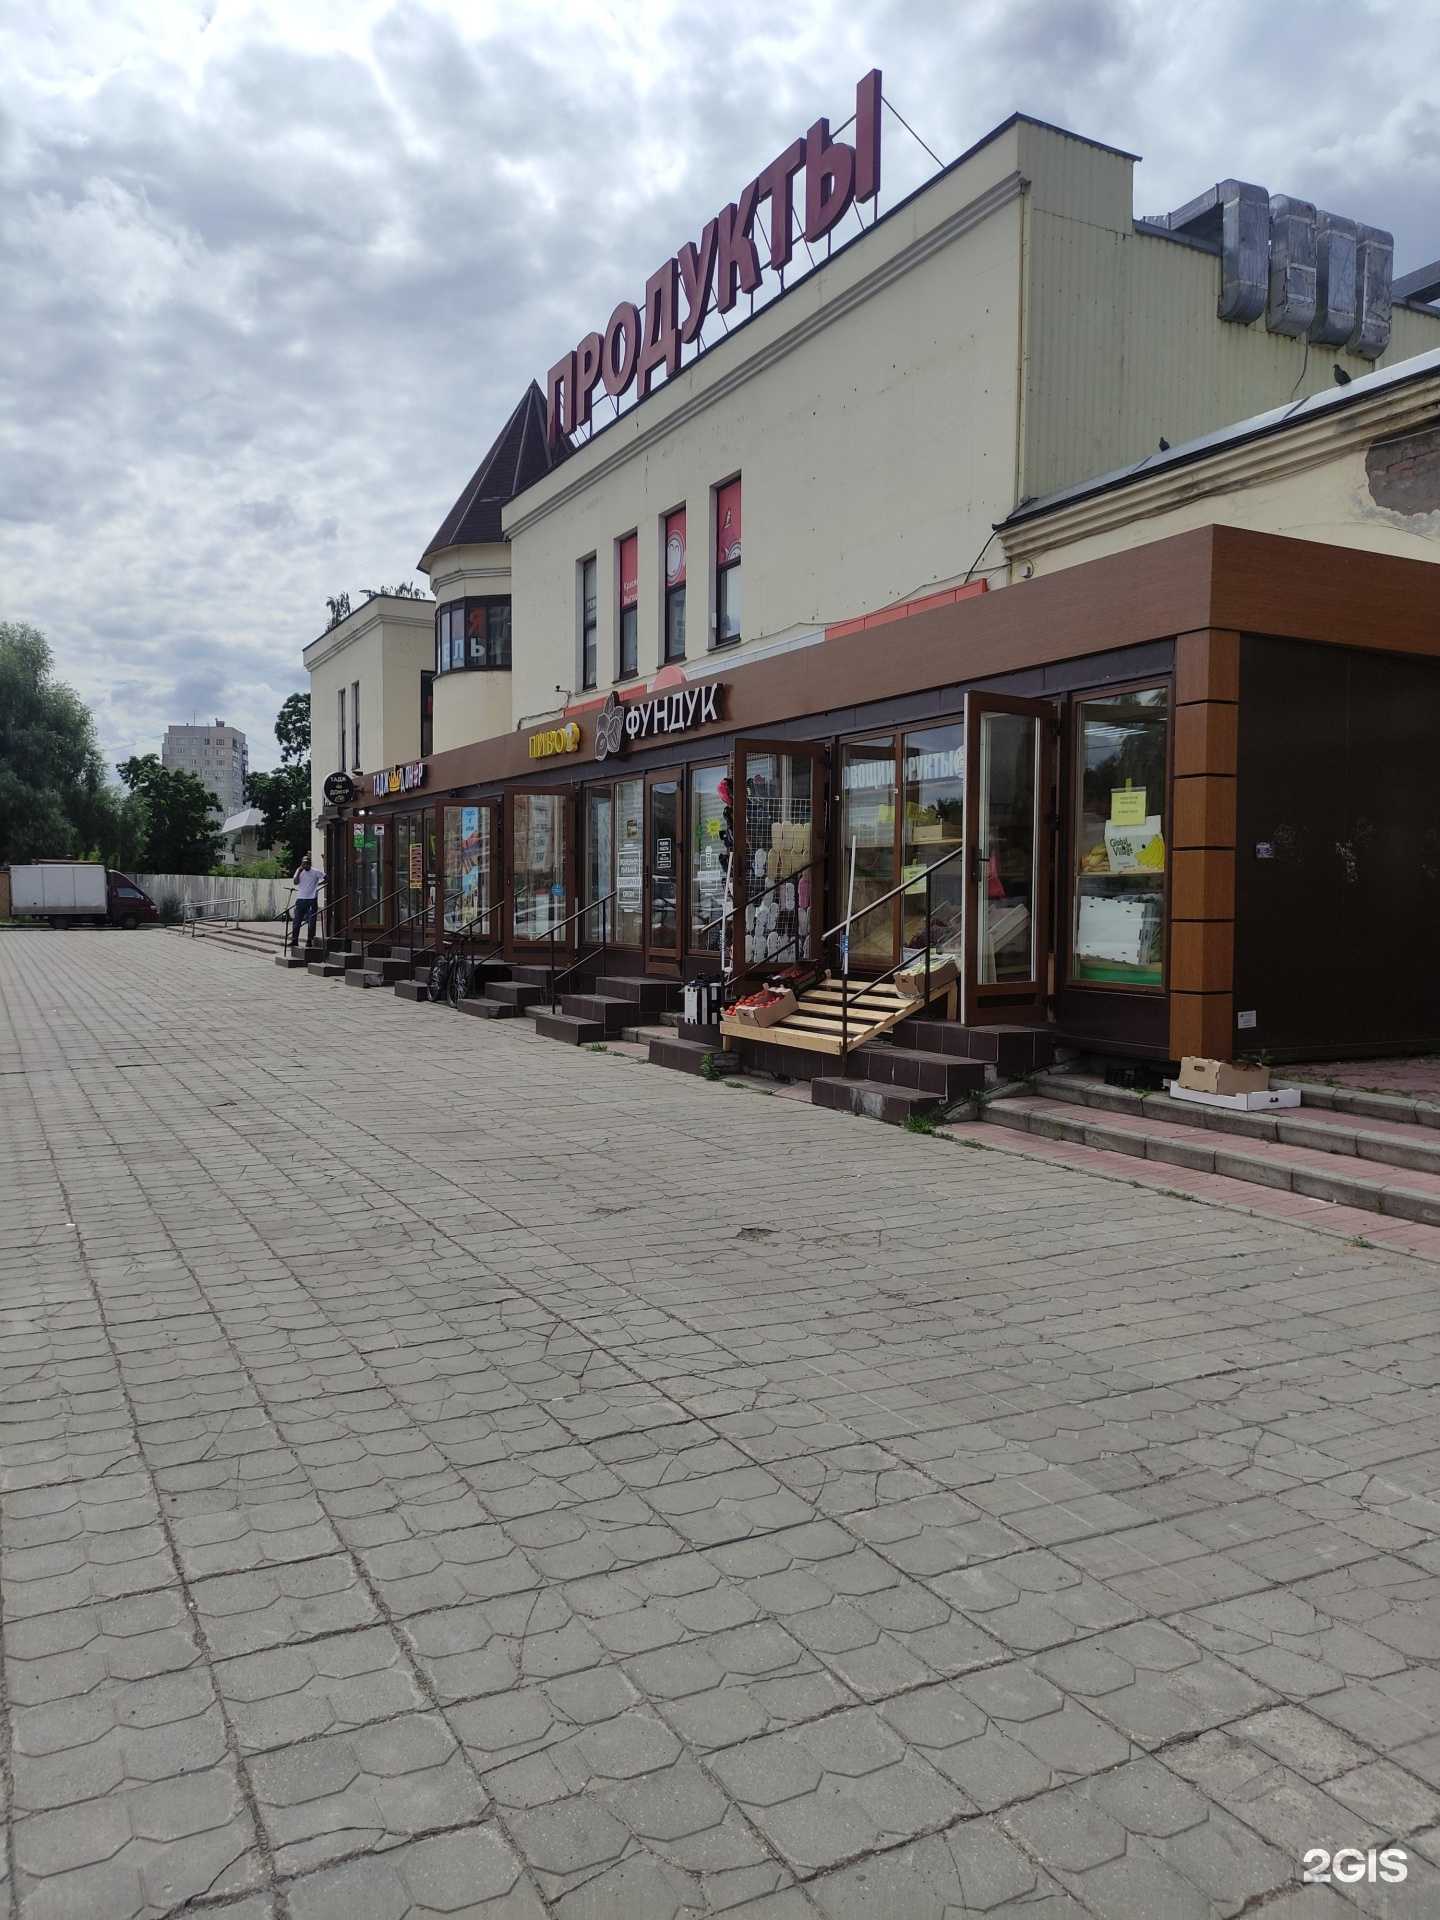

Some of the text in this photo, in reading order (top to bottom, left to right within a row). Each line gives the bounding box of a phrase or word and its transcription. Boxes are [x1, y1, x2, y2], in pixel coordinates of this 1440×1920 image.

[546, 68, 882, 448] ПРОДУКТЫ
[625, 683, 720, 740] ФУНДУК
[528, 728, 567, 760] ПИВО
